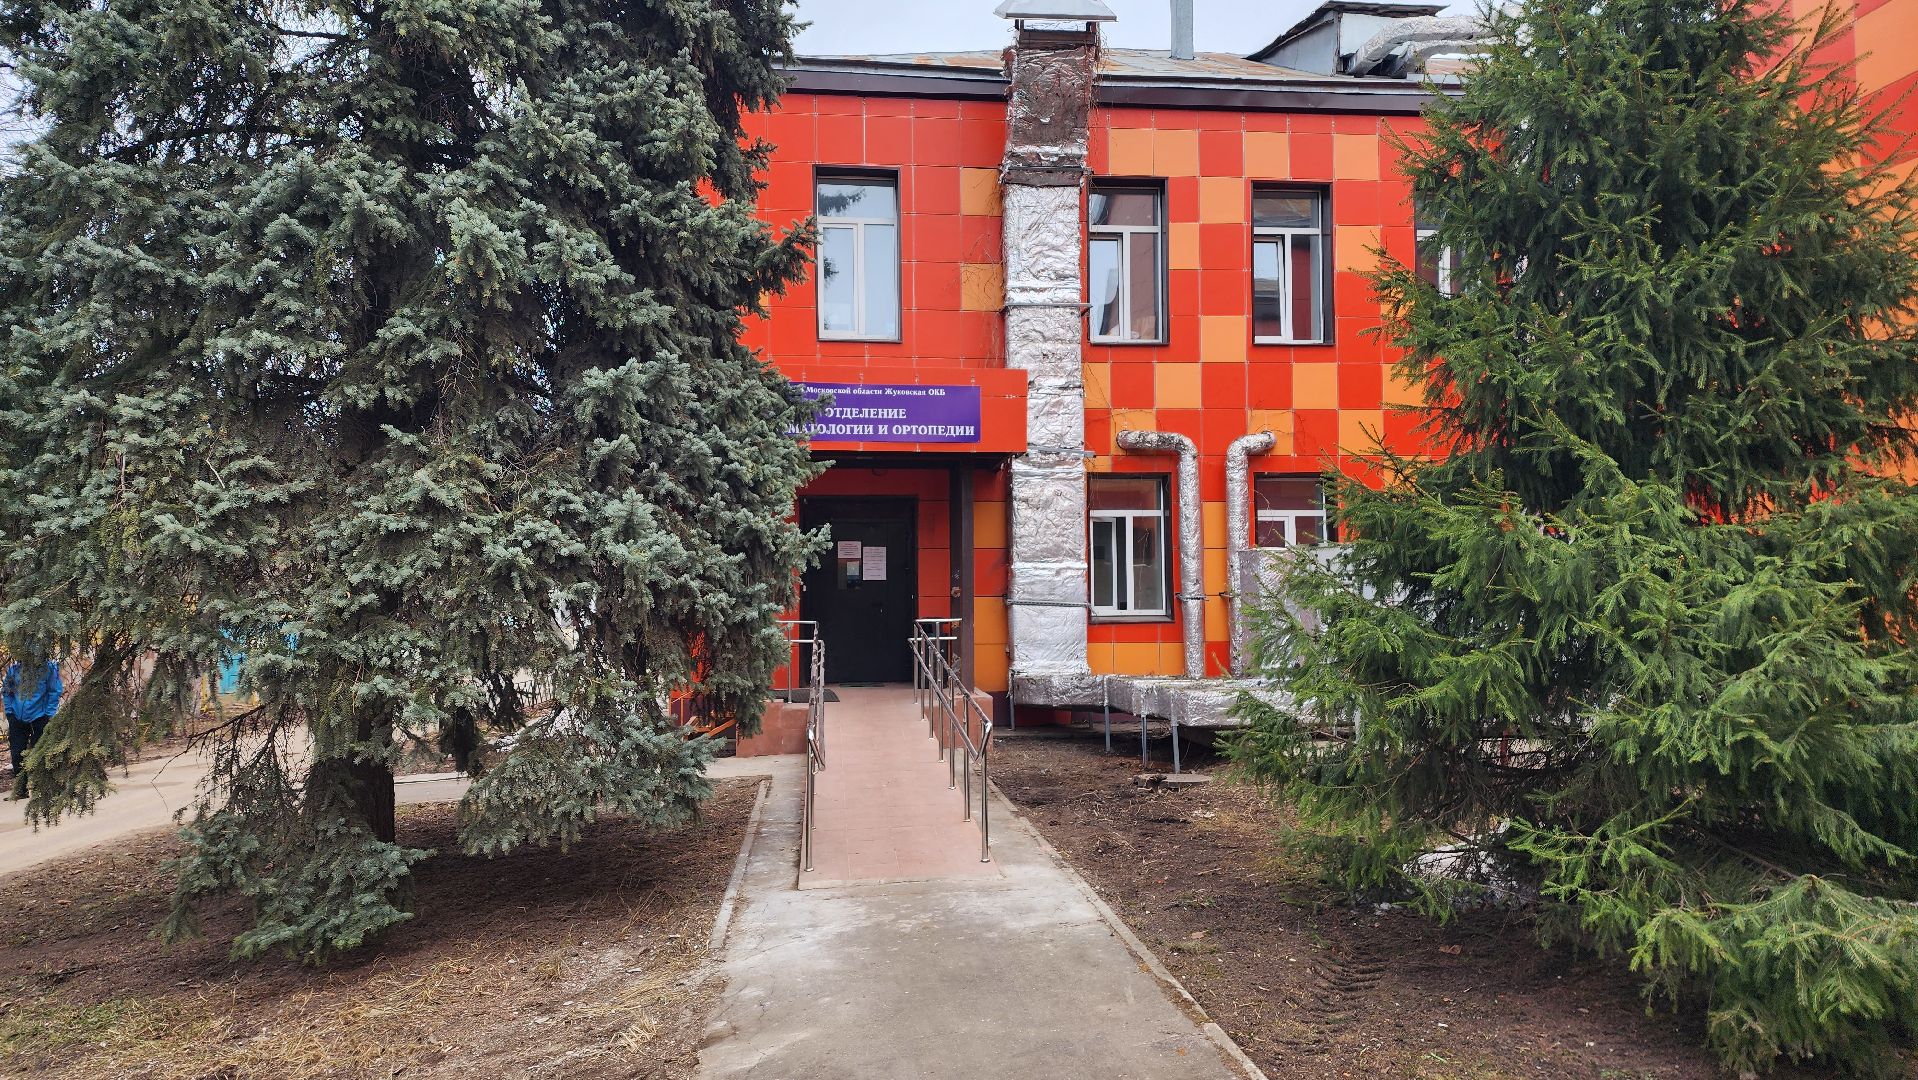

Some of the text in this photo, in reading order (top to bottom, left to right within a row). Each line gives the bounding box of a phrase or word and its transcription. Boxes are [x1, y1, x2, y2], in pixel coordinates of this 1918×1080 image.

[806, 386, 851, 394] Московской
[852, 387, 882, 395] области
[884, 388, 926, 396] Жуковская
[928, 388, 946, 396] ОКБ
[825, 407, 907, 419] ОТДЕЛЕНИЕ
[783, 423, 975, 438] МАТОЛОГИИ И ОРТОПЕДИИ
